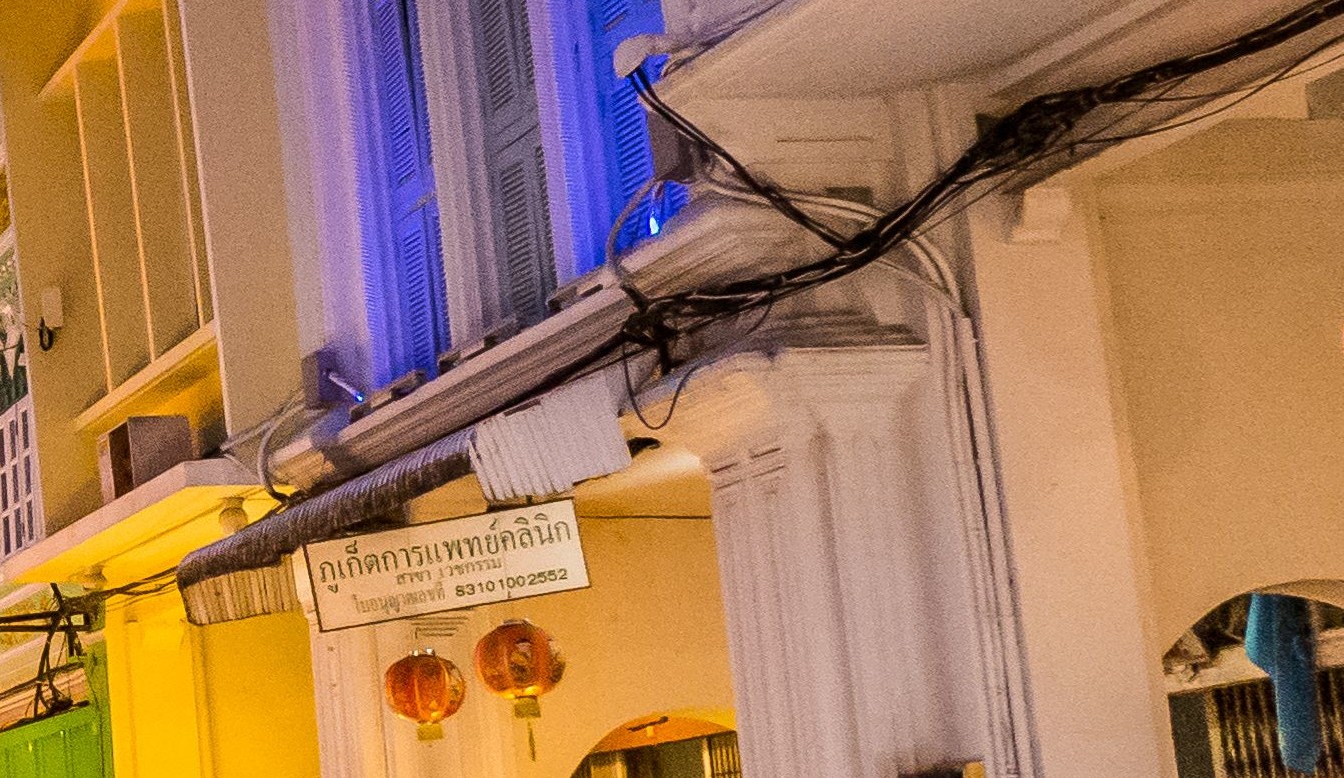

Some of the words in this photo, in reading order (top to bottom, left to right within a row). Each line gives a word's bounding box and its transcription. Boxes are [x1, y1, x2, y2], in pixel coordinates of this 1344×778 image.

[319, 512, 571, 593] ภูเก็ตการแพทย์คลินิก
